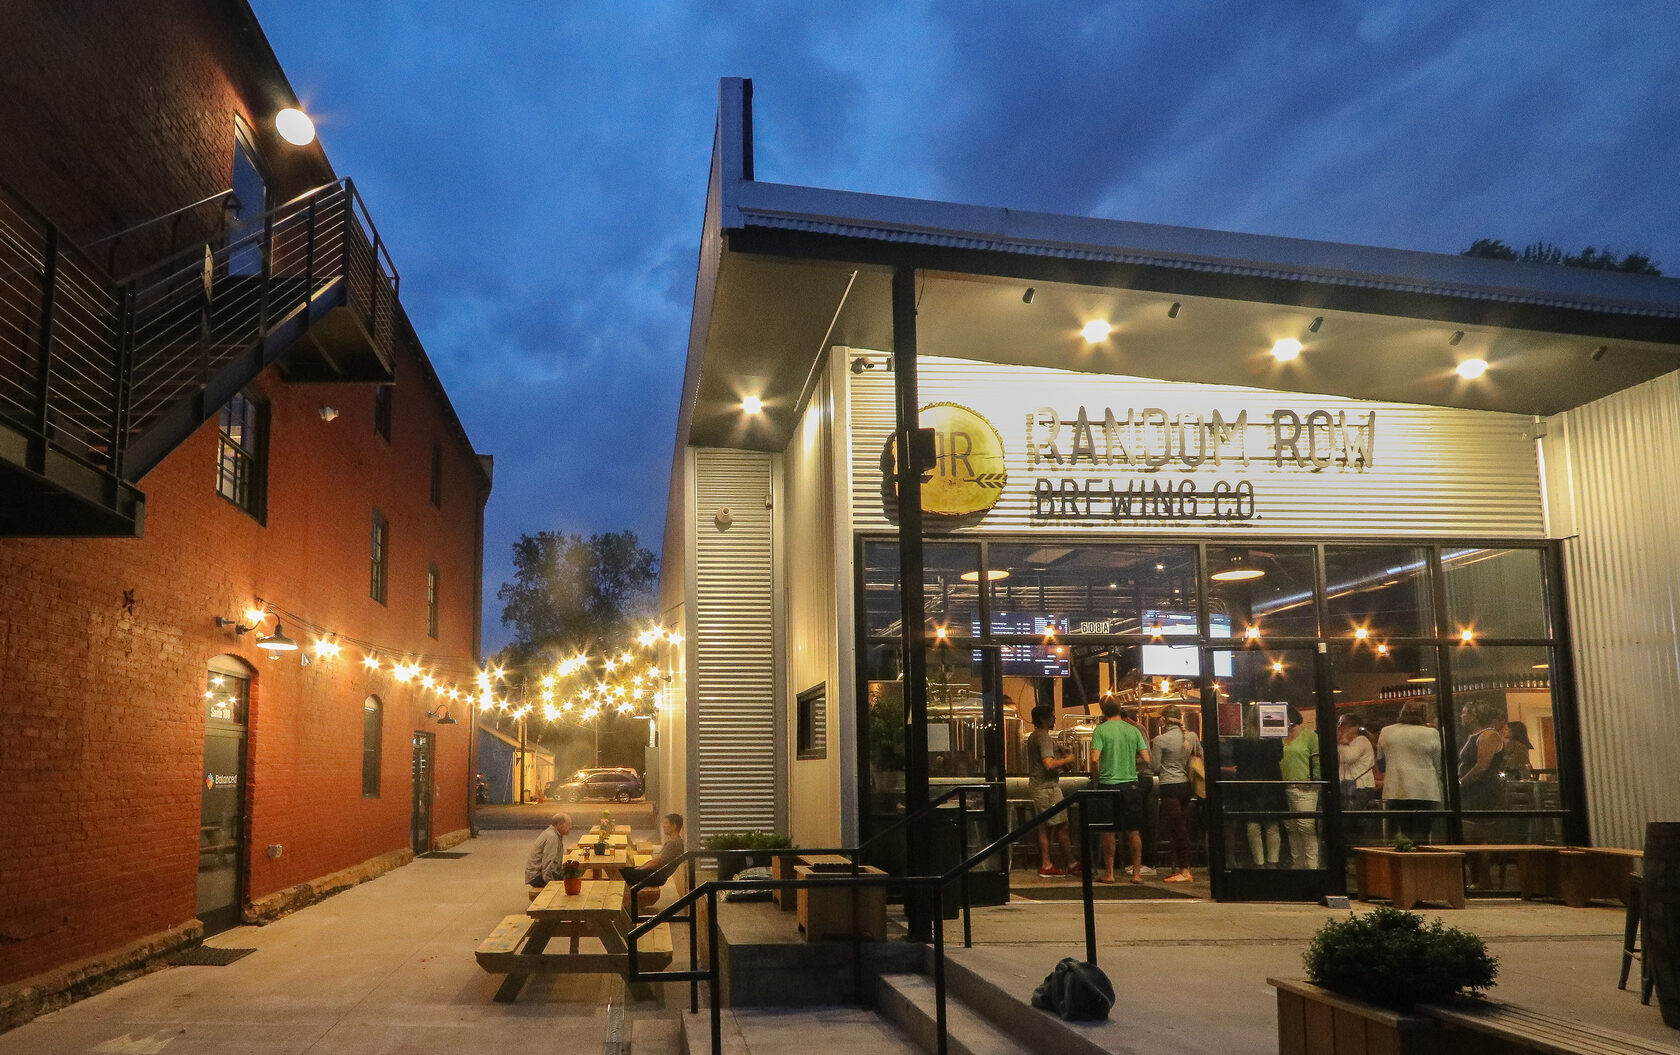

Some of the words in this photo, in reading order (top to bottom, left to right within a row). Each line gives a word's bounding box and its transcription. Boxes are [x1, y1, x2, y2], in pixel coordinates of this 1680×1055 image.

[1032, 405, 1250, 467] RANDOM
[1272, 409, 1376, 469] ROW
[1035, 479, 1198, 522] BREWING
[1080, 621, 1110, 634] 608A
[215, 774, 237, 784] Balanced
